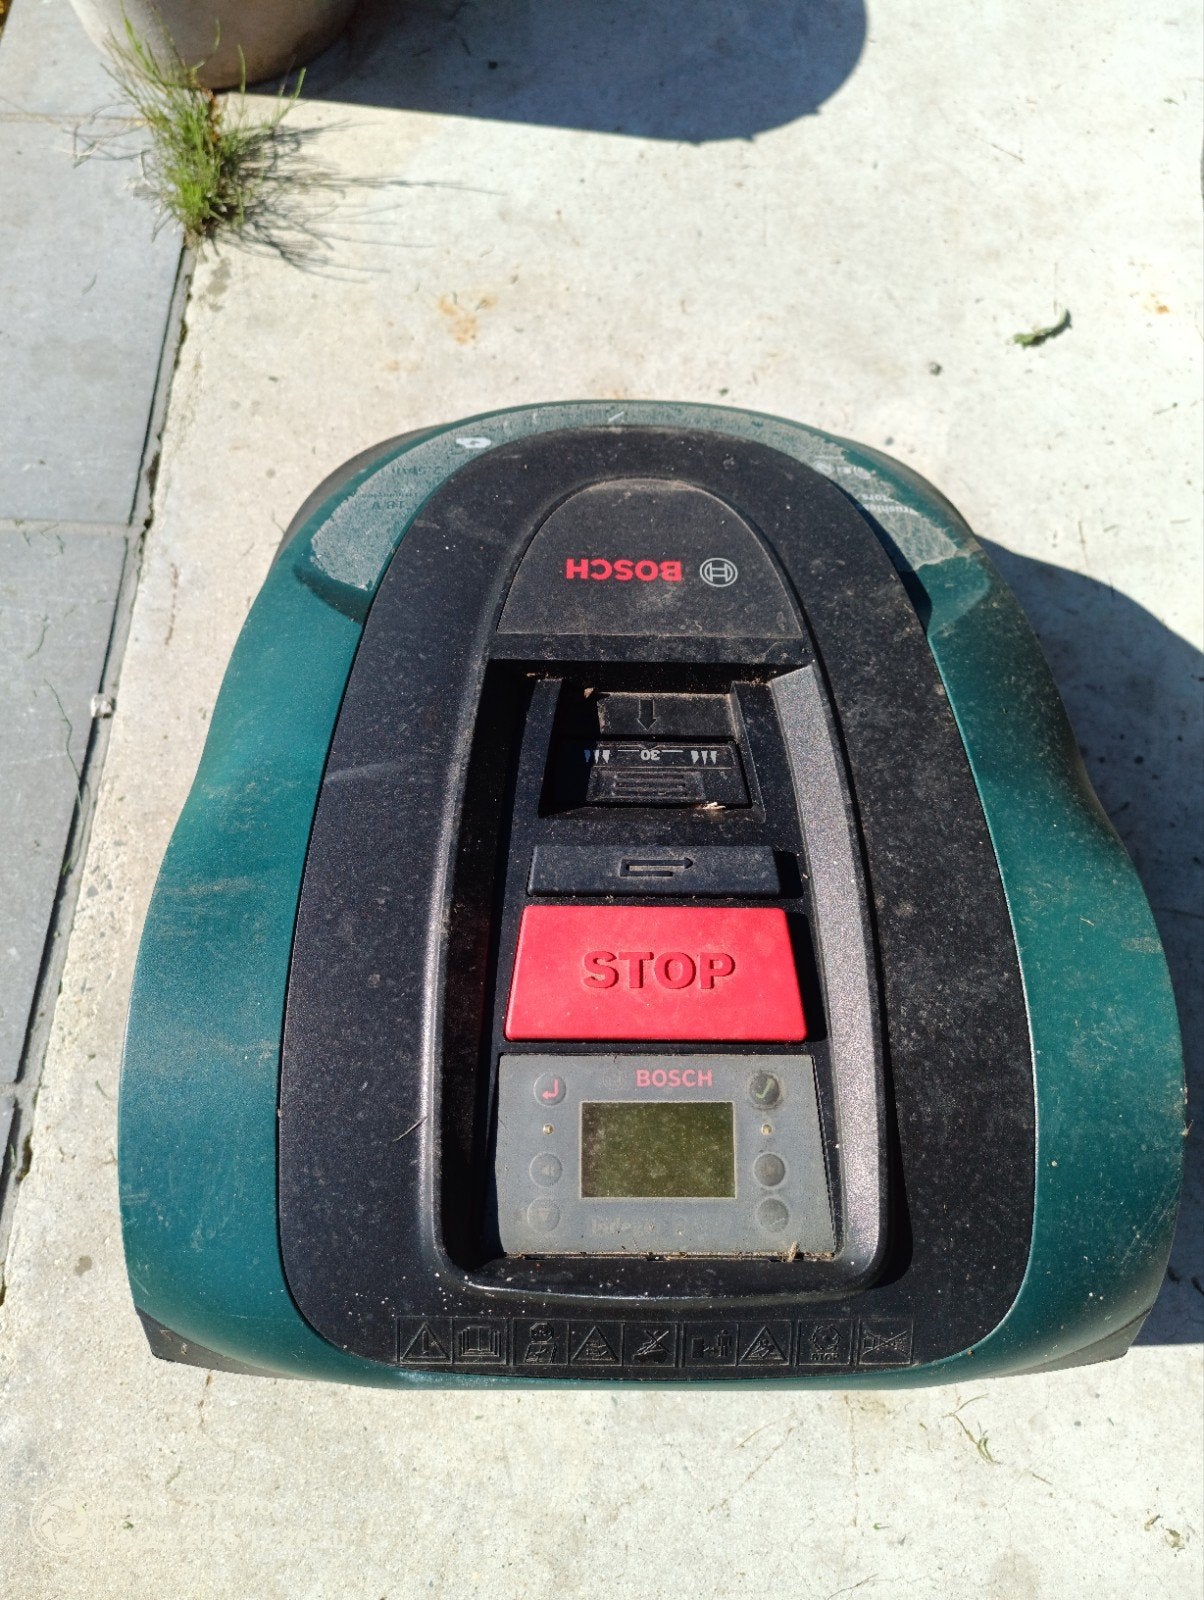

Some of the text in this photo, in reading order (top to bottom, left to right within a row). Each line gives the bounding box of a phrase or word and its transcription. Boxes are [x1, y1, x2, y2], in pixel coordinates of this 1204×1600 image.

[565, 557, 684, 583] BOSCH
[640, 749, 661, 761] 30
[583, 950, 736, 990] STOP
[635, 1068, 714, 1088] BOSCH
